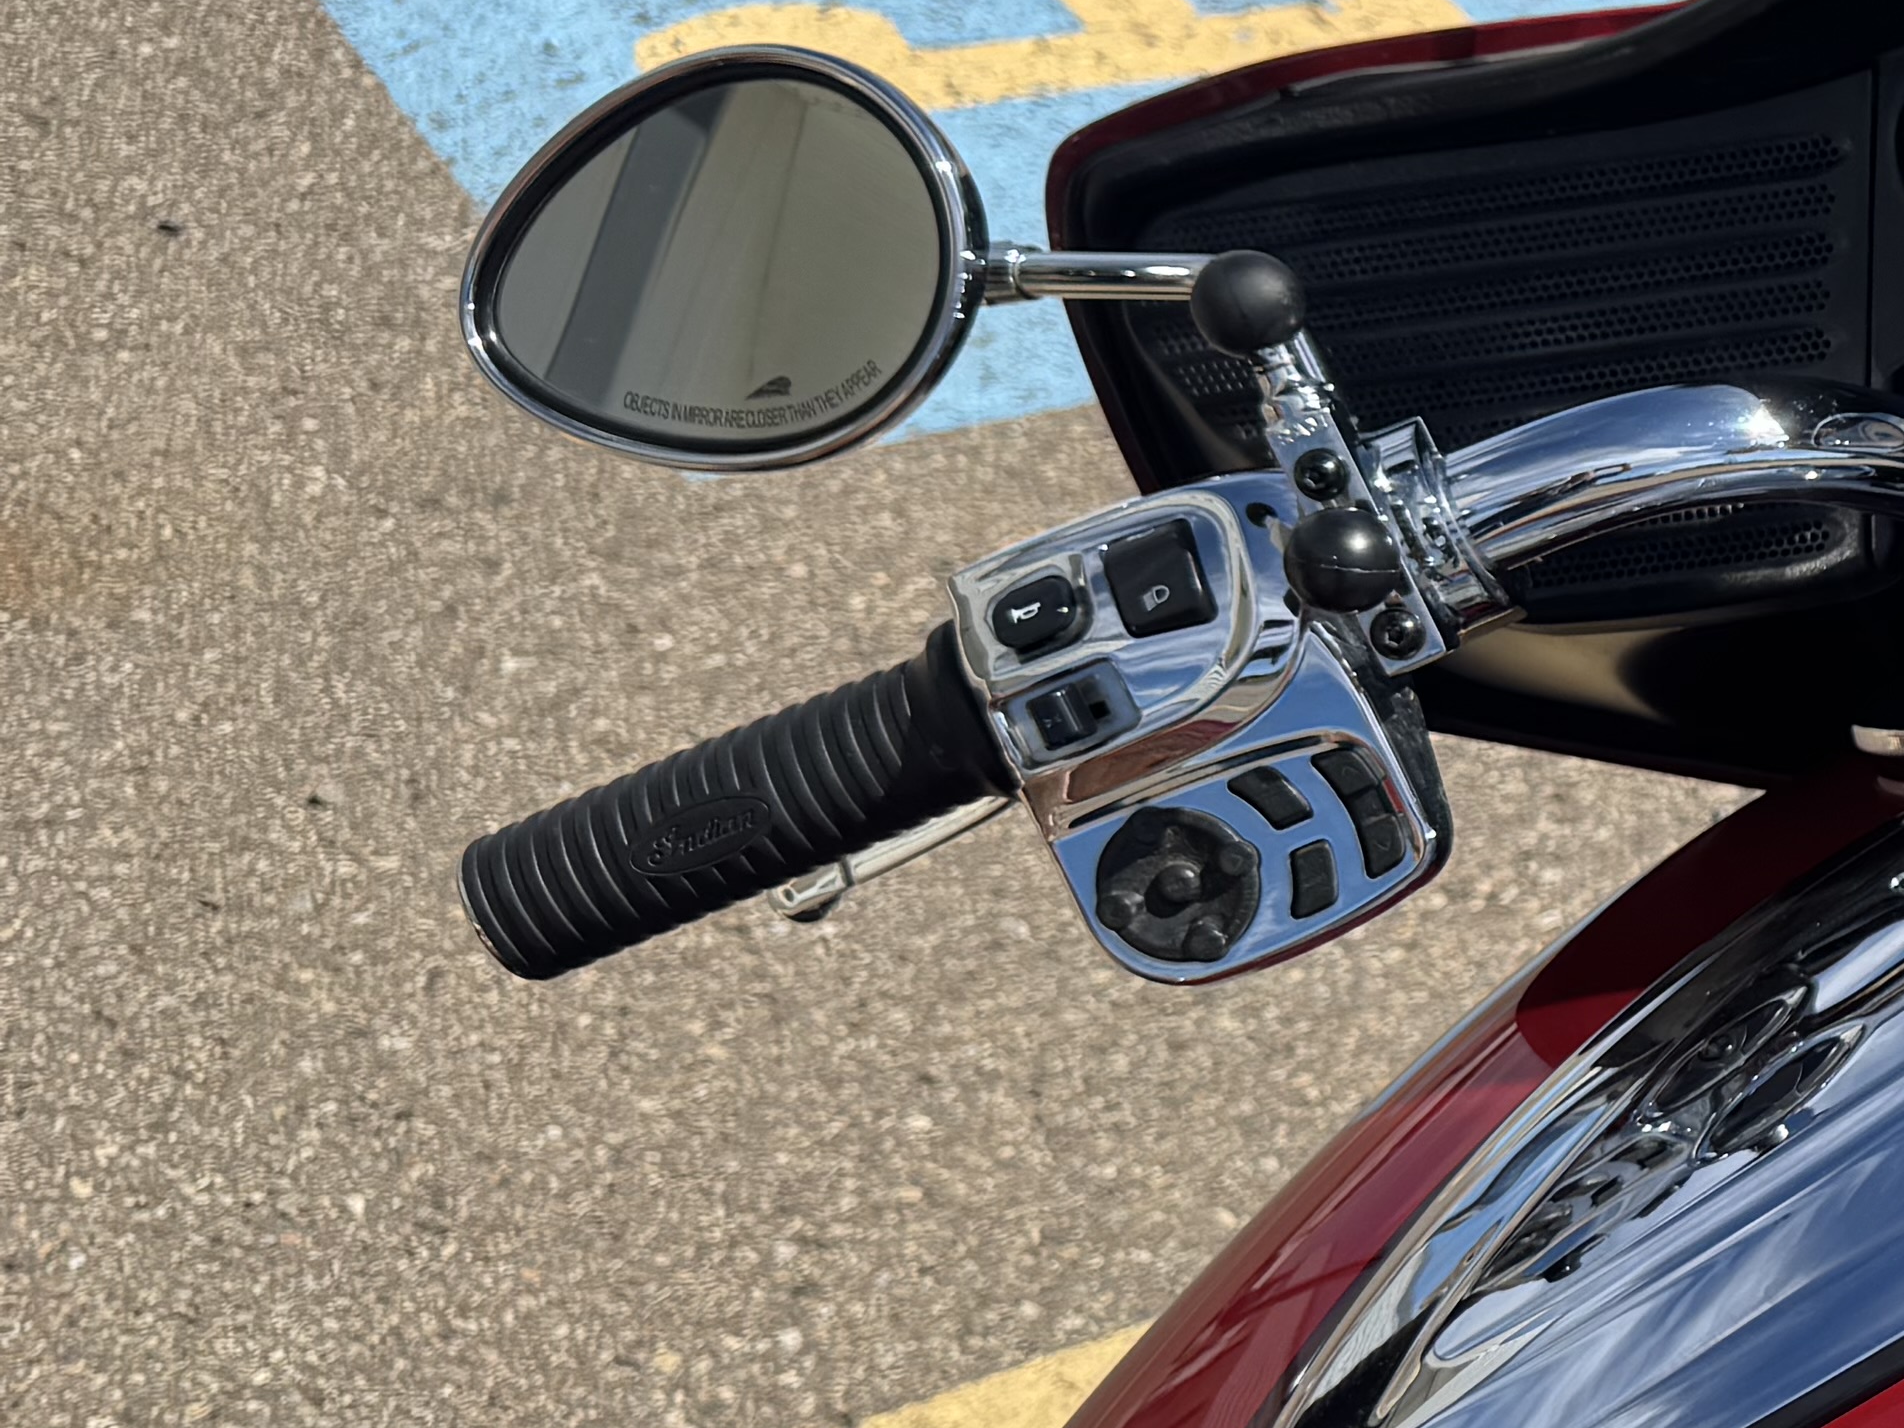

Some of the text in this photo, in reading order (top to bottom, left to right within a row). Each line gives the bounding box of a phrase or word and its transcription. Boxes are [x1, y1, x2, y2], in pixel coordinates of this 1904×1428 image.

[623, 390, 670, 420] OBJECTS
[684, 404, 723, 427] MIRROR
[745, 407, 788, 429] CLOSER
[814, 385, 844, 414] THEY
[841, 359, 882, 400] APPEAR
[645, 807, 755, 869] Indian
